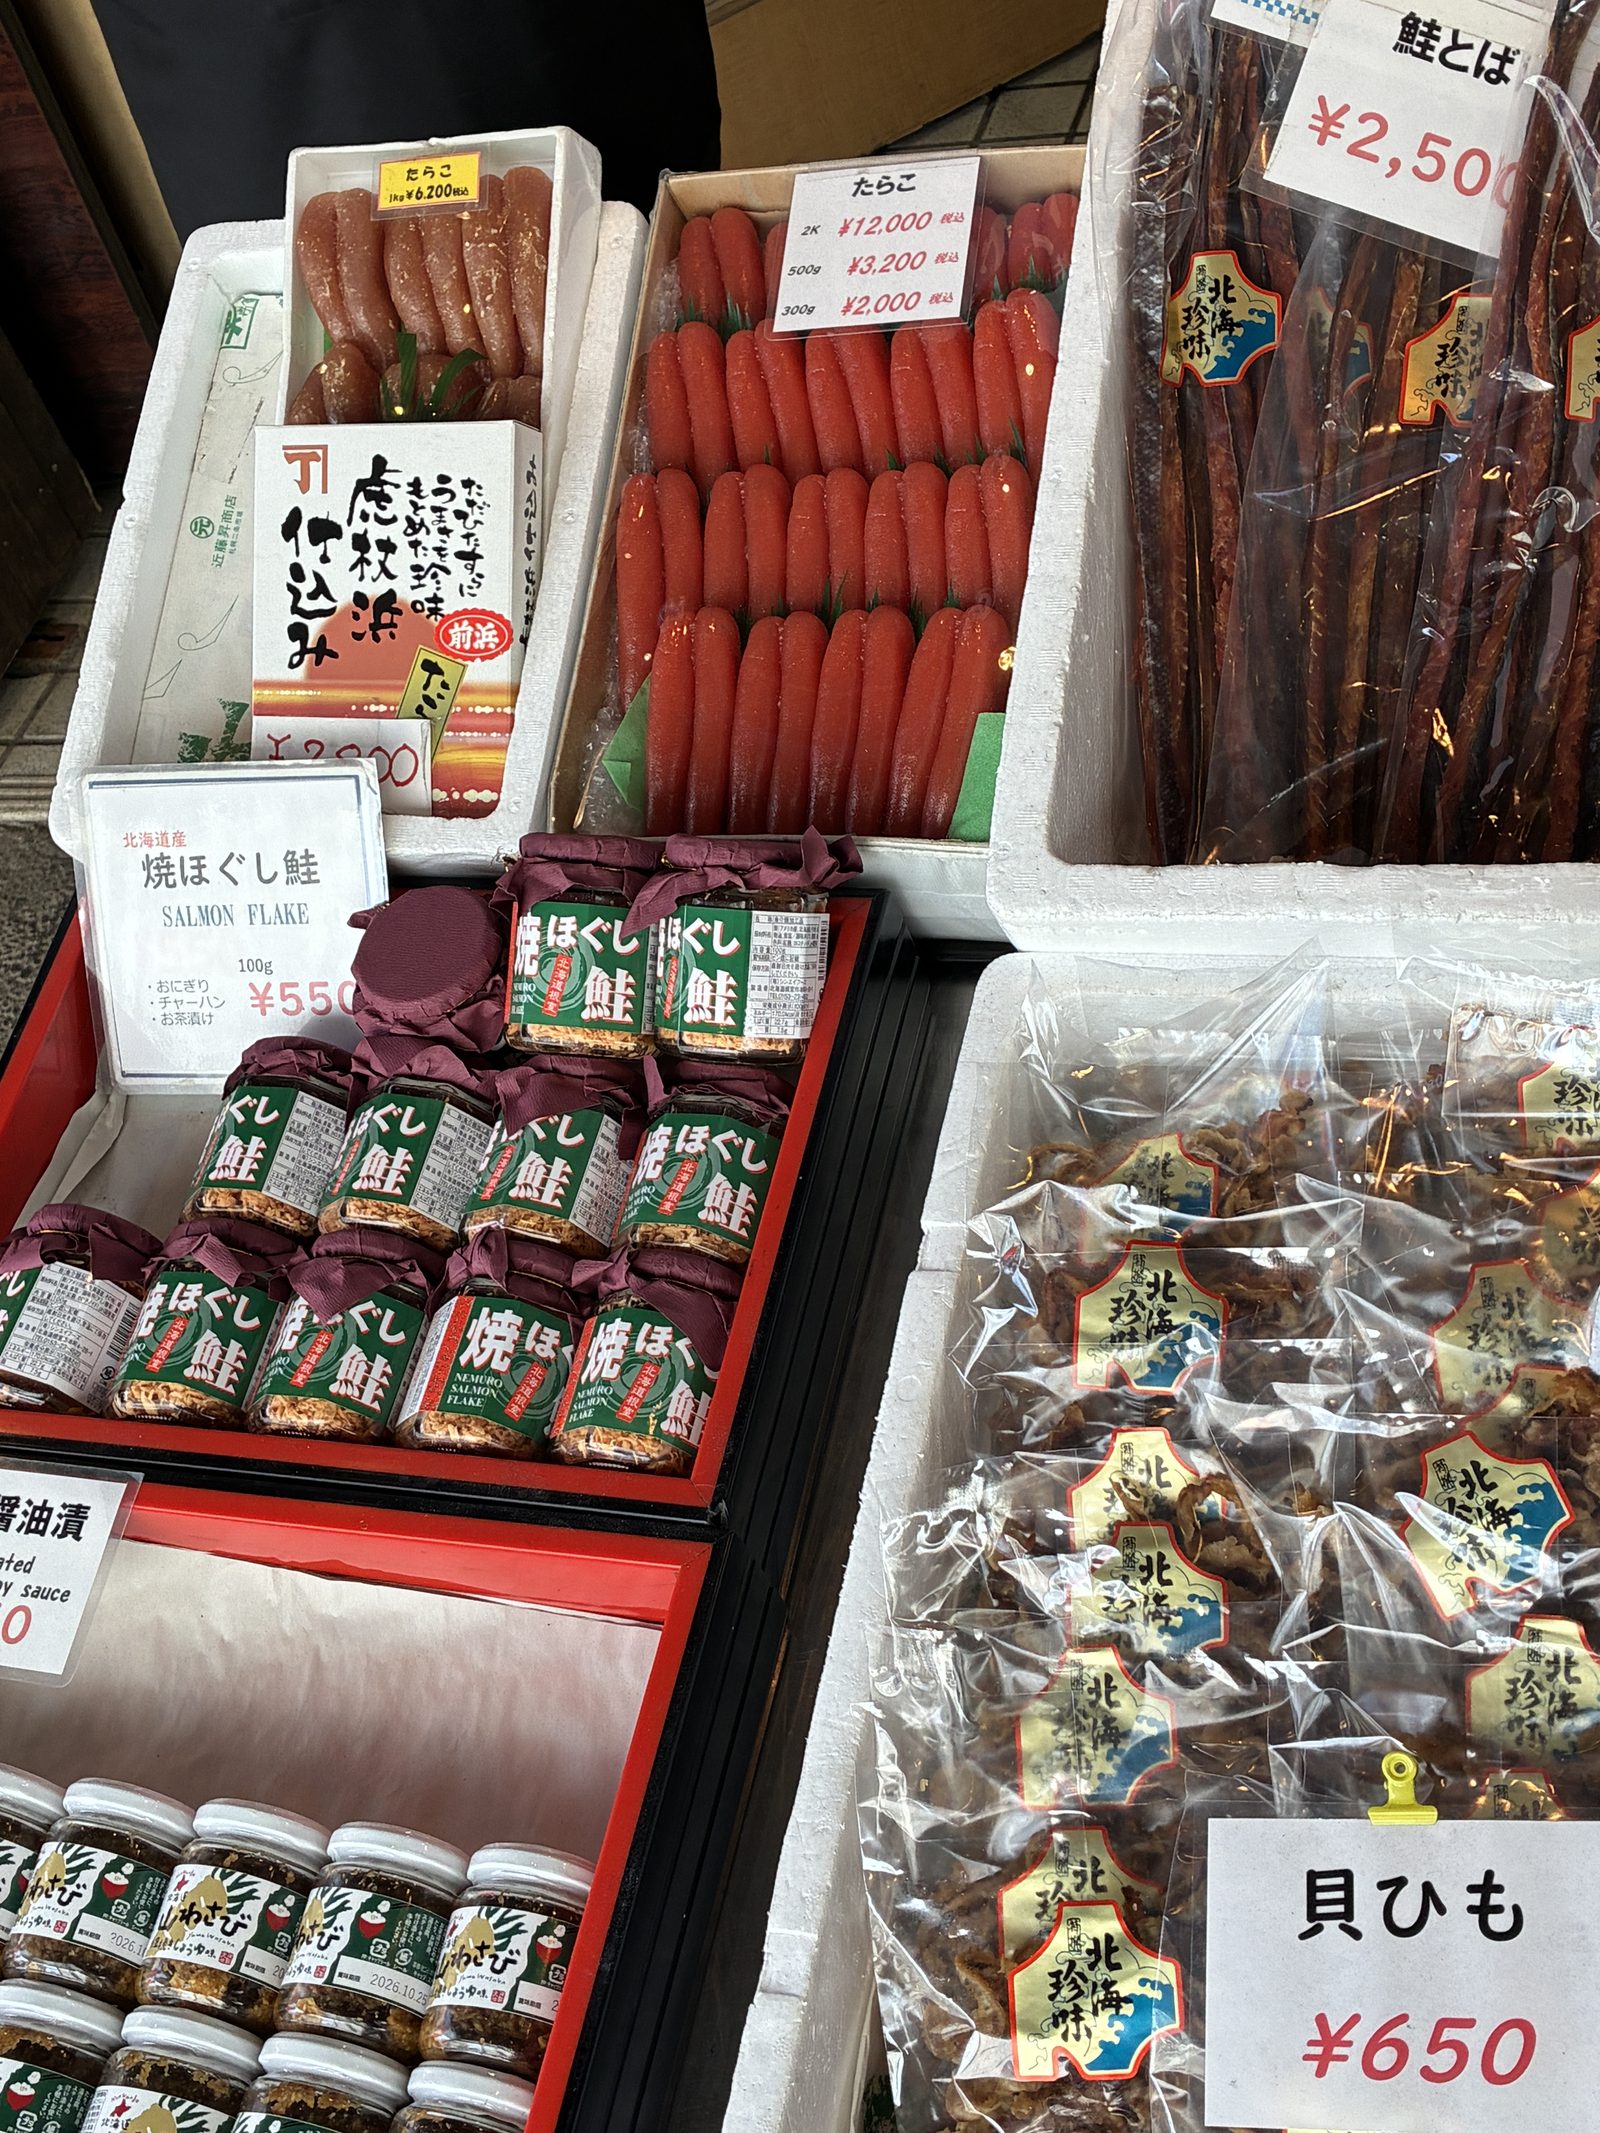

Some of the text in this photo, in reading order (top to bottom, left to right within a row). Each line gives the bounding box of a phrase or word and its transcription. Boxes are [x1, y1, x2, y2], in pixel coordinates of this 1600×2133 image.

[1392, 11, 1521, 86] 鮭とば
[406, 164, 451, 181] たらこ
[851, 173, 917, 197] たらこ
[801, 211, 965, 238] 2K ¥12,000 税込
[787, 251, 959, 276] 500g ¥3,200 税込
[781, 291, 953, 317] 300g ¥2,000 税込
[453, 477, 490, 598] ただひたすらに
[281, 506, 343, 670] 仕込み
[449, 620, 500, 649] 前浜
[123, 831, 187, 848] 北海道産
[142, 848, 320, 889] 焼ほぐし鮭
[162, 903, 309, 928] SALMON FLAKE
[239, 958, 274, 975] 100g
[581, 965, 636, 1024] 鮭
[684, 965, 738, 1026] 鮭
[208, 1134, 267, 1183] 鮭
[352, 1143, 414, 1196] 鮭
[508, 1150, 574, 1209] 鮭
[632, 1122, 769, 1188] 焼ほぐし
[697, 1172, 758, 1240] 鮭
[183, 1329, 247, 1395] 鮭
[329, 1343, 393, 1413] 鮭
[446, 1394, 485, 1408] FLAKE
[450, 1383, 500, 1399] SALMON
[504, 1361, 549, 1422] 北海道根室
[615, 1361, 662, 1424] 北海道根室
[20, 1582, 71, 1603] sauce
[1298, 1868, 1524, 1942] 貝ひも
[370, 1973, 428, 2007] 2026.10.25
[1048, 1960, 1091, 2042] 珍味
[1302, 2012, 1537, 2086] ¥650
